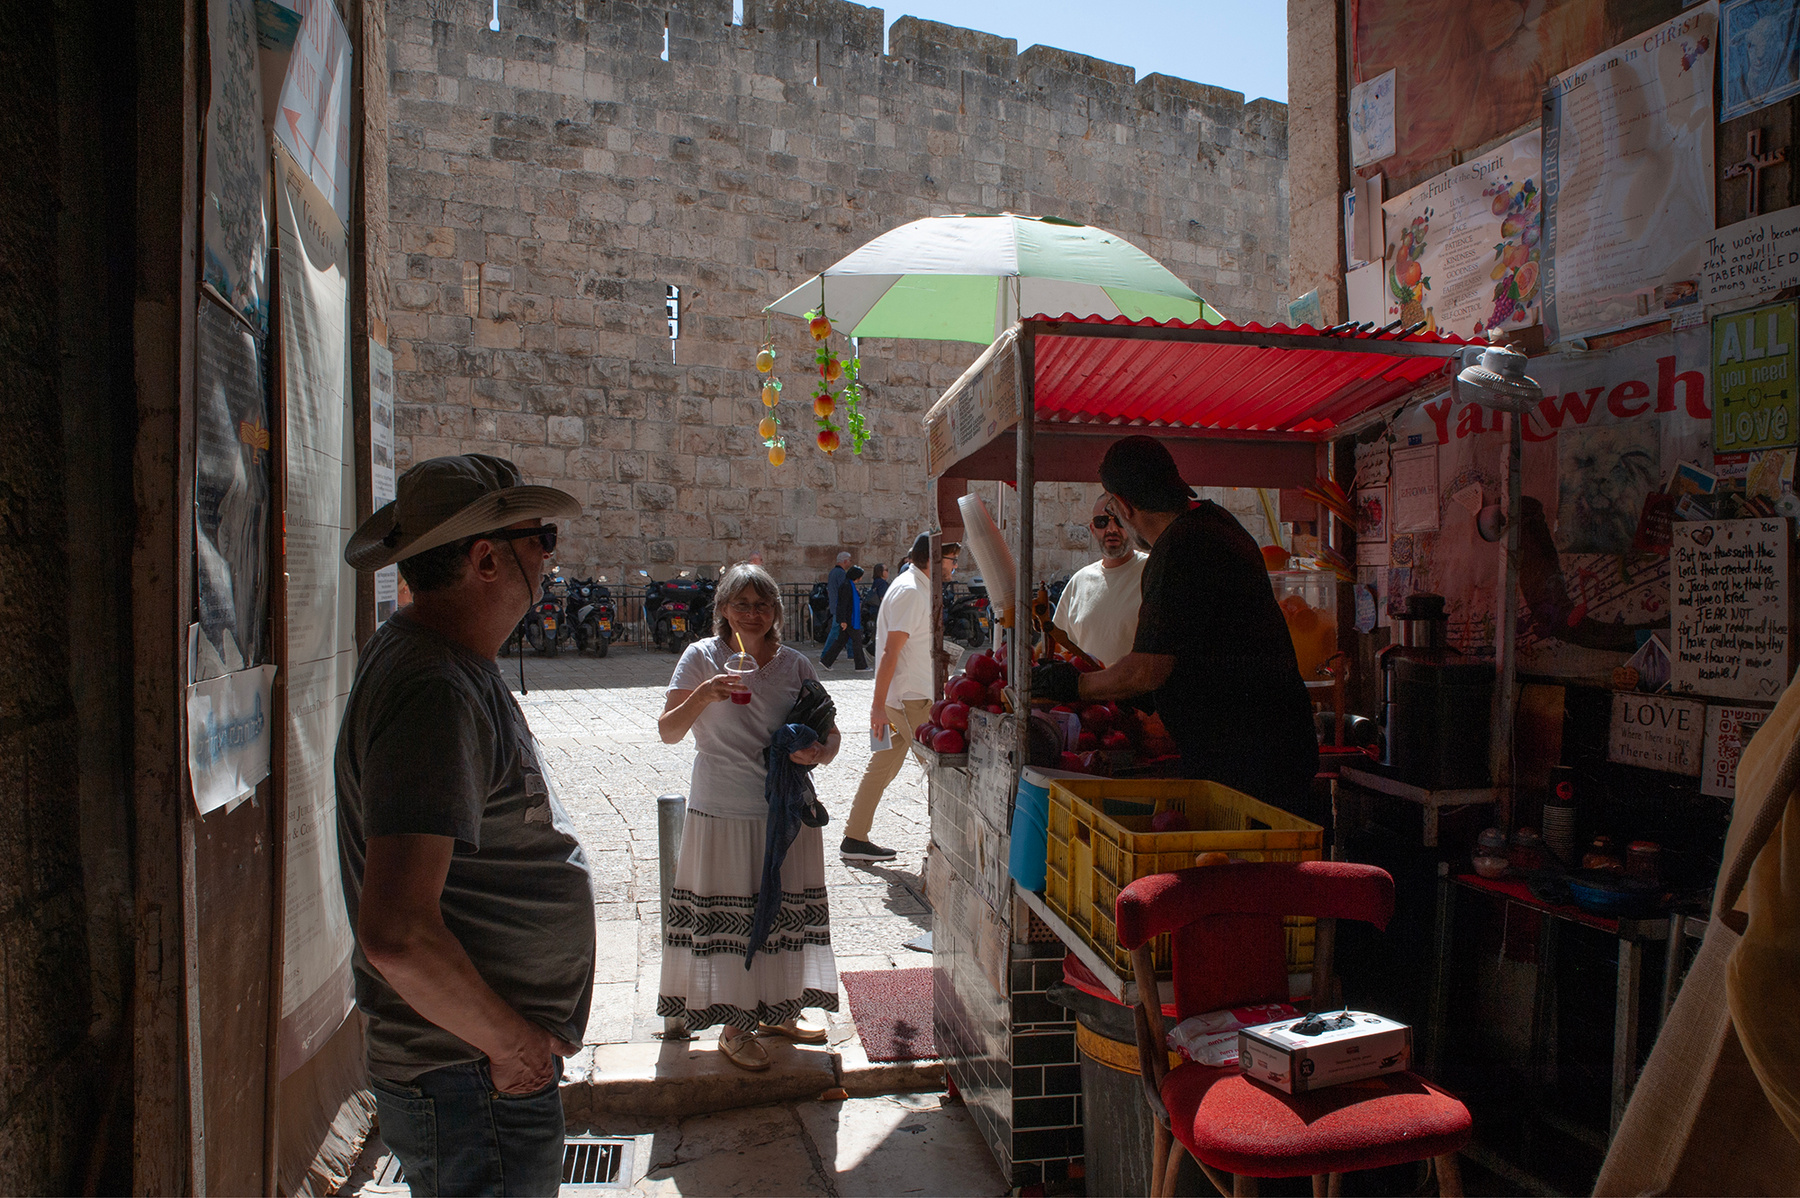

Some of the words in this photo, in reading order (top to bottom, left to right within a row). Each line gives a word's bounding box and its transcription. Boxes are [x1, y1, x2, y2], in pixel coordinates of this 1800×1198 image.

[1562, 71, 1587, 90] Who
[1600, 57, 1619, 73] am
[1624, 49, 1638, 62] in
[1428, 177, 1452, 199] Fruit
[1458, 171, 1471, 182] the
[1471, 156, 1504, 179] Spirit
[1449, 195, 1465, 207] LOVE
[1546, 203, 1557, 220] in
[1448, 223, 1467, 235] PEACE
[1444, 235, 1473, 251] PATIENCE
[1549, 226, 1556, 250] am
[1705, 237, 1727, 256] The
[1732, 226, 1764, 249] word
[1771, 225, 1800, 240] becam
[1446, 249, 1476, 266] KINDNESS
[1446, 263, 1479, 279] GOODNESS
[1707, 251, 1799, 283] TABERNACLED
[1545, 267, 1556, 308] Who
[1710, 280, 1746, 294] among
[1759, 285, 1776, 293] John
[1719, 313, 1789, 366] ALL
[1720, 369, 1746, 394] you
[1752, 356, 1787, 383] need
[1755, 541, 1776, 557] the
[1678, 561, 1697, 578] Lord
[1700, 561, 1719, 577] that
[1721, 560, 1751, 575] created
[1712, 576, 1729, 590] and
[1743, 576, 1762, 591] that
[1696, 606, 1727, 622] FEAR
[1731, 607, 1754, 620] NOT
[1702, 620, 1721, 634] have
[1687, 636, 1706, 650] have
[1623, 702, 1690, 731] LOVE
[1621, 728, 1641, 740] Where
[1674, 736, 1690, 748] Love
[1619, 744, 1649, 759] There
[1653, 749, 1662, 761] is
[1668, 751, 1689, 766] Life
